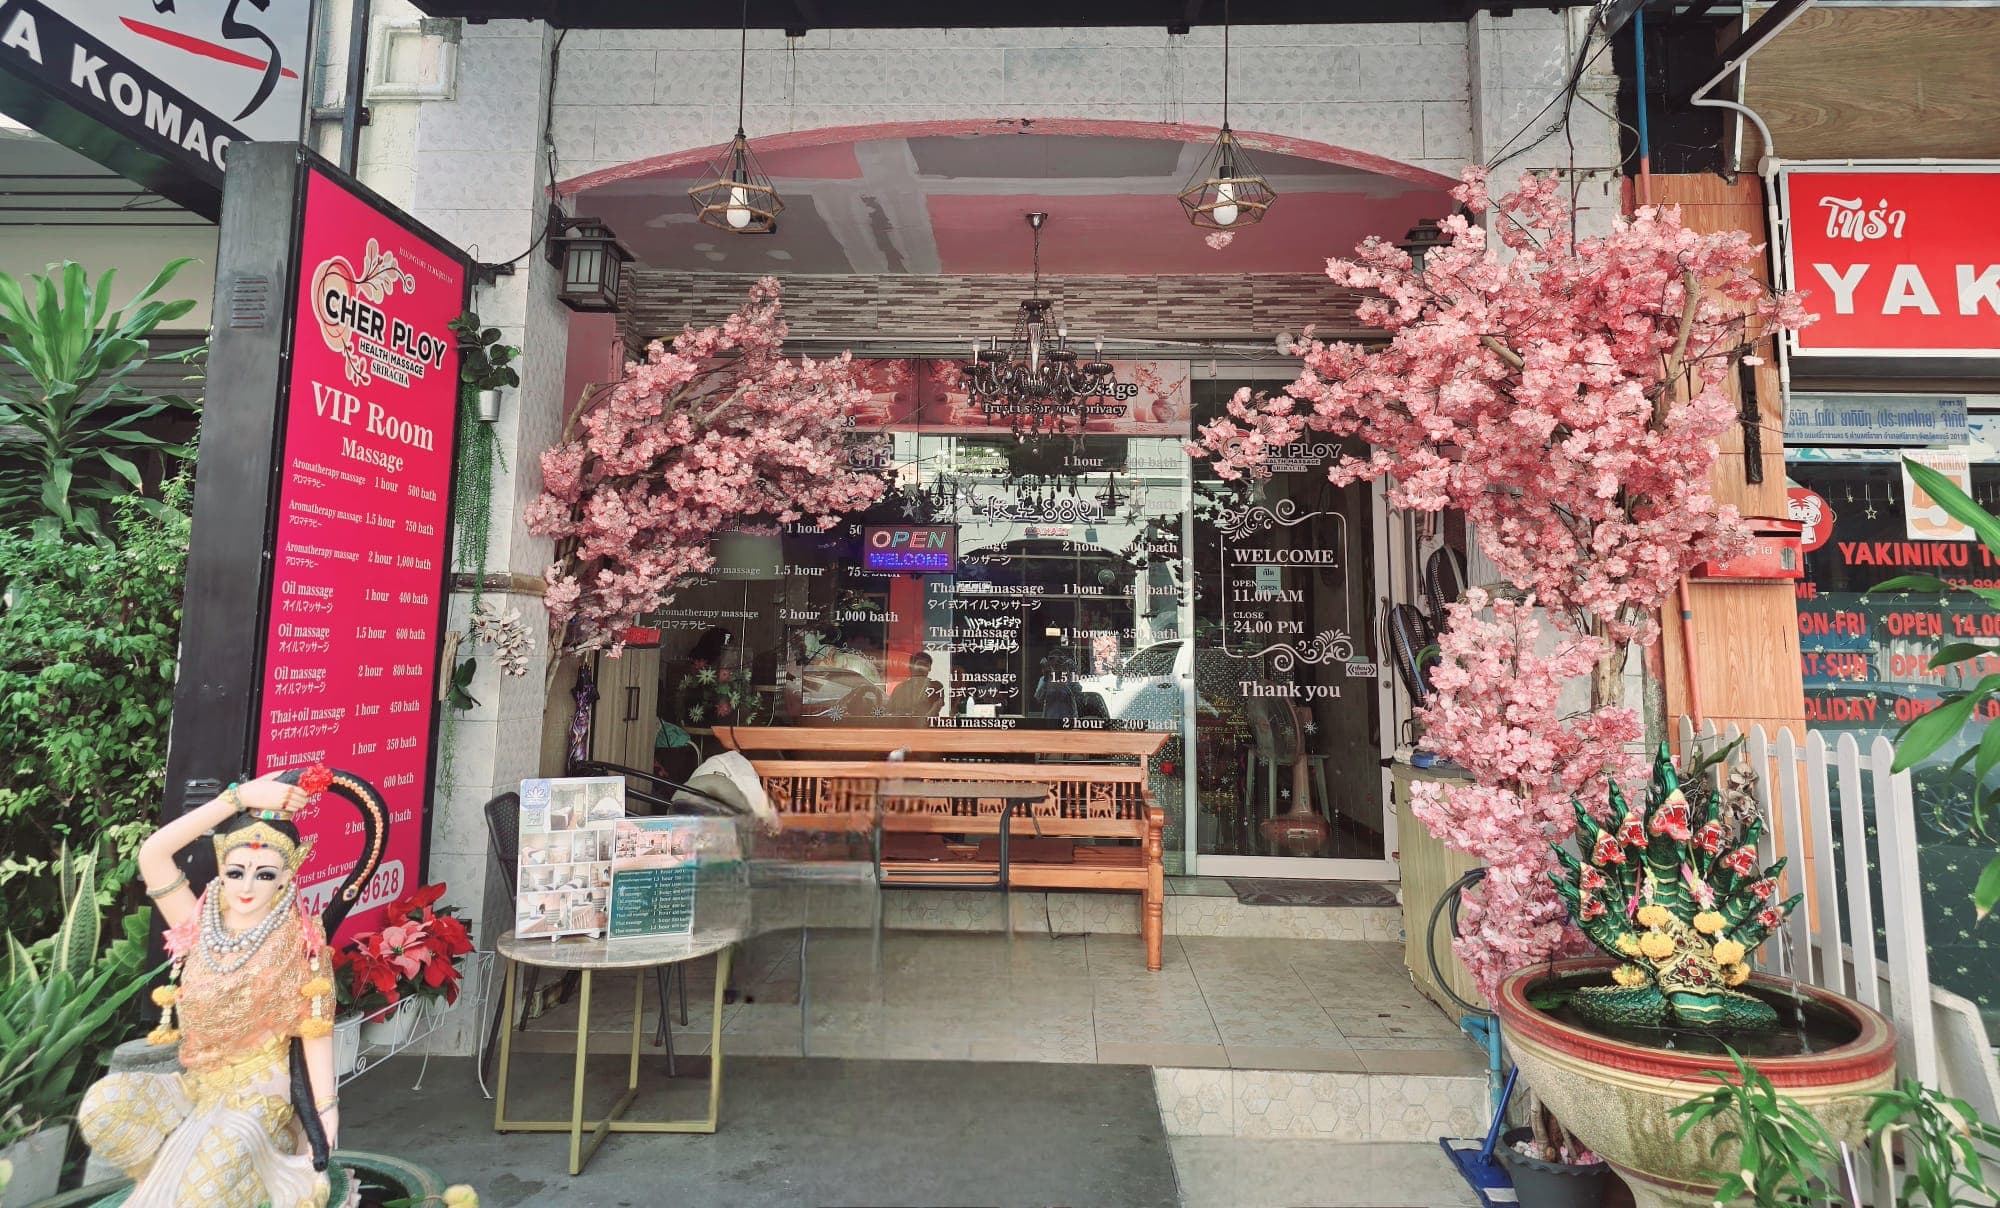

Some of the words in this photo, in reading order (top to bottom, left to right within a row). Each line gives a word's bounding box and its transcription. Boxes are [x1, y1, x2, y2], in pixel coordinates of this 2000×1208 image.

[325, 289, 384, 341] CHER
[392, 322, 447, 367] PLOY
[360, 341, 389, 360] HEALTH
[390, 352, 424, 376] MASSAGE
[372, 362, 409, 386] SRIRACHA
[312, 381, 360, 425] VIP
[366, 402, 433, 451] Room
[341, 437, 404, 473] Massage
[1289, 444, 1341, 458] PLOY
[1070, 456, 1104, 467] hour
[293, 457, 339, 479] Aromatherapy
[340, 471, 366, 485] massage
[381, 478, 399, 492] hour
[408, 485, 420, 497] 500
[421, 486, 437, 501] bath
[289, 500, 336, 519] Aromatherapy
[337, 510, 363, 523] massage
[366, 512, 376, 524] 1.5
[377, 513, 396, 529] hour
[405, 520, 417, 533] 750
[418, 521, 434, 536] bath
[872, 530, 947, 549] OPEN
[1062, 541, 1070, 552] 2
[1072, 541, 1103, 552] hour
[1148, 542, 1177, 553] bath
[285, 541, 332, 559] Aromatherapy
[333, 550, 360, 564] massage
[374, 551, 393, 565] hour
[396, 555, 414, 569] 1,000
[415, 557, 431, 571] bath
[870, 552, 949, 568] WELCOME
[1233, 549, 1334, 563] WELCOME
[1838, 542, 1968, 566] YAKINIKU
[723, 567, 761, 577] massage
[773, 565, 791, 575] 1.5
[795, 565, 825, 577] hour
[1073, 584, 1104, 594] hour
[1232, 580, 1257, 588] OPEN
[282, 580, 296, 595] Oil
[297, 584, 334, 600] massage
[371, 589, 390, 602] hour
[399, 592, 411, 604] 400
[412, 593, 428, 605] bath
[1233, 589, 1272, 602] 11.00
[1275, 590, 1304, 602] AM
[282, 600, 333, 614] オイルマッサージ
[928, 599, 1041, 611] タイ式オイルマッサージ
[653, 608, 719, 619] Aromatherapy
[721, 610, 759, 619] massage
[779, 609, 787, 619] 2
[790, 608, 821, 620] hour
[835, 610, 867, 622] 1,000
[869, 610, 898, 622] bath
[1233, 611, 1264, 619] CLOSE
[1233, 621, 1273, 633] 24.00
[1277, 621, 1304, 634] PM
[1798, 612, 1867, 635] ON-FRI
[1888, 613, 1943, 636] OPEN
[278, 623, 292, 637] Oil
[293, 627, 330, 641] massage
[355, 626, 367, 639] 1.5
[368, 627, 386, 639] hour
[396, 628, 408, 640] 600
[409, 629, 425, 641] bath
[930, 626, 959, 637] Thai
[963, 628, 1017, 641] massage
[279, 641, 330, 653] オイルマッサージ
[274, 667, 289, 680] Oil
[290, 668, 326, 681] massage
[358, 665, 363, 677] 2
[364, 665, 383, 677] hour
[392, 665, 405, 676] 800
[406, 664, 422, 676] bath
[1801, 653, 1867, 677] AT-SUN
[961, 673, 1017, 685] massage
[1051, 672, 1068, 682] 1.5
[275, 681, 326, 695] オイルマッサージ
[1239, 681, 1301, 697] Thank
[1305, 685, 1341, 702] you
[271, 707, 309, 724] Thai+oil
[311, 706, 346, 721] massage
[361, 704, 380, 716] hour
[390, 701, 402, 713] 450
[403, 700, 420, 712] bath
[1804, 697, 1877, 721] OLIDAY
[928, 716, 956, 728] Thai
[960, 718, 1016, 730] massage
[1062, 717, 1069, 728] 2
[1072, 717, 1105, 730] hour
[266, 751, 288, 768] Thai
[290, 749, 326, 764] massage
[357, 742, 377, 754] hour
[386, 739, 398, 751] 350
[400, 736, 417, 749] bath
[384, 776, 396, 788] 600
[397, 773, 414, 786] bath
[395, 809, 411, 823] bath
[345, 823, 350, 835] 2
[316, 867, 326, 879] us
[327, 863, 339, 876] for
